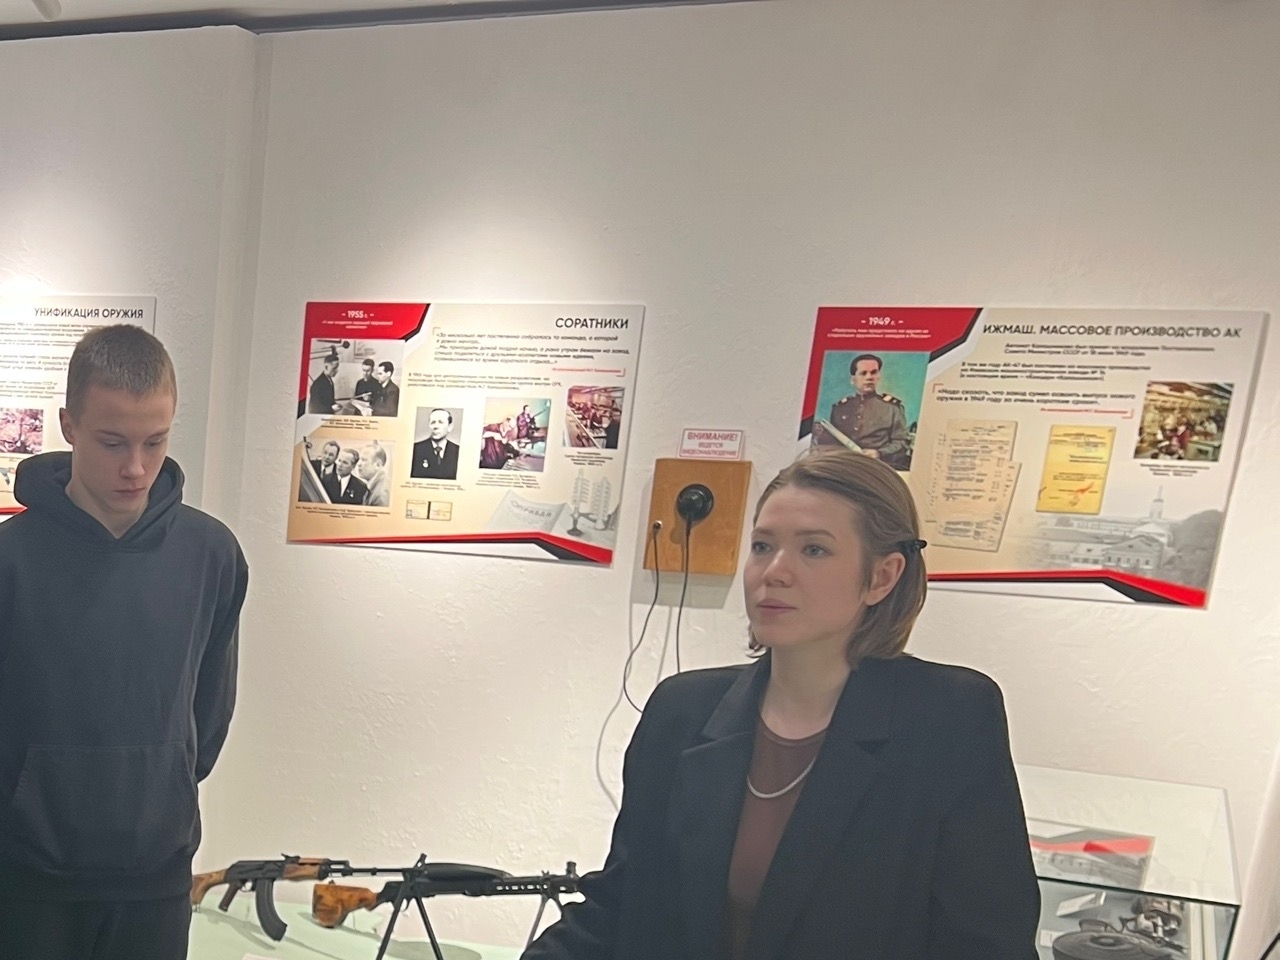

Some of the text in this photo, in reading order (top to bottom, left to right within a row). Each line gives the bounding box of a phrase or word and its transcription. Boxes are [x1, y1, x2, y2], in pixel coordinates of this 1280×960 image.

[34, 308, 144, 318] УНИФИКАЦИЯ ОРУЖИЯ
[555, 318, 629, 329] СОРАТНИКИ
[868, 317, 891, 325] 1949
[983, 324, 1242, 338] ИЖМАШ. МАССОВОЕ ПРОИЗВОДСТВО АК
[688, 432, 738, 441] ВНИМАНИЕ!
